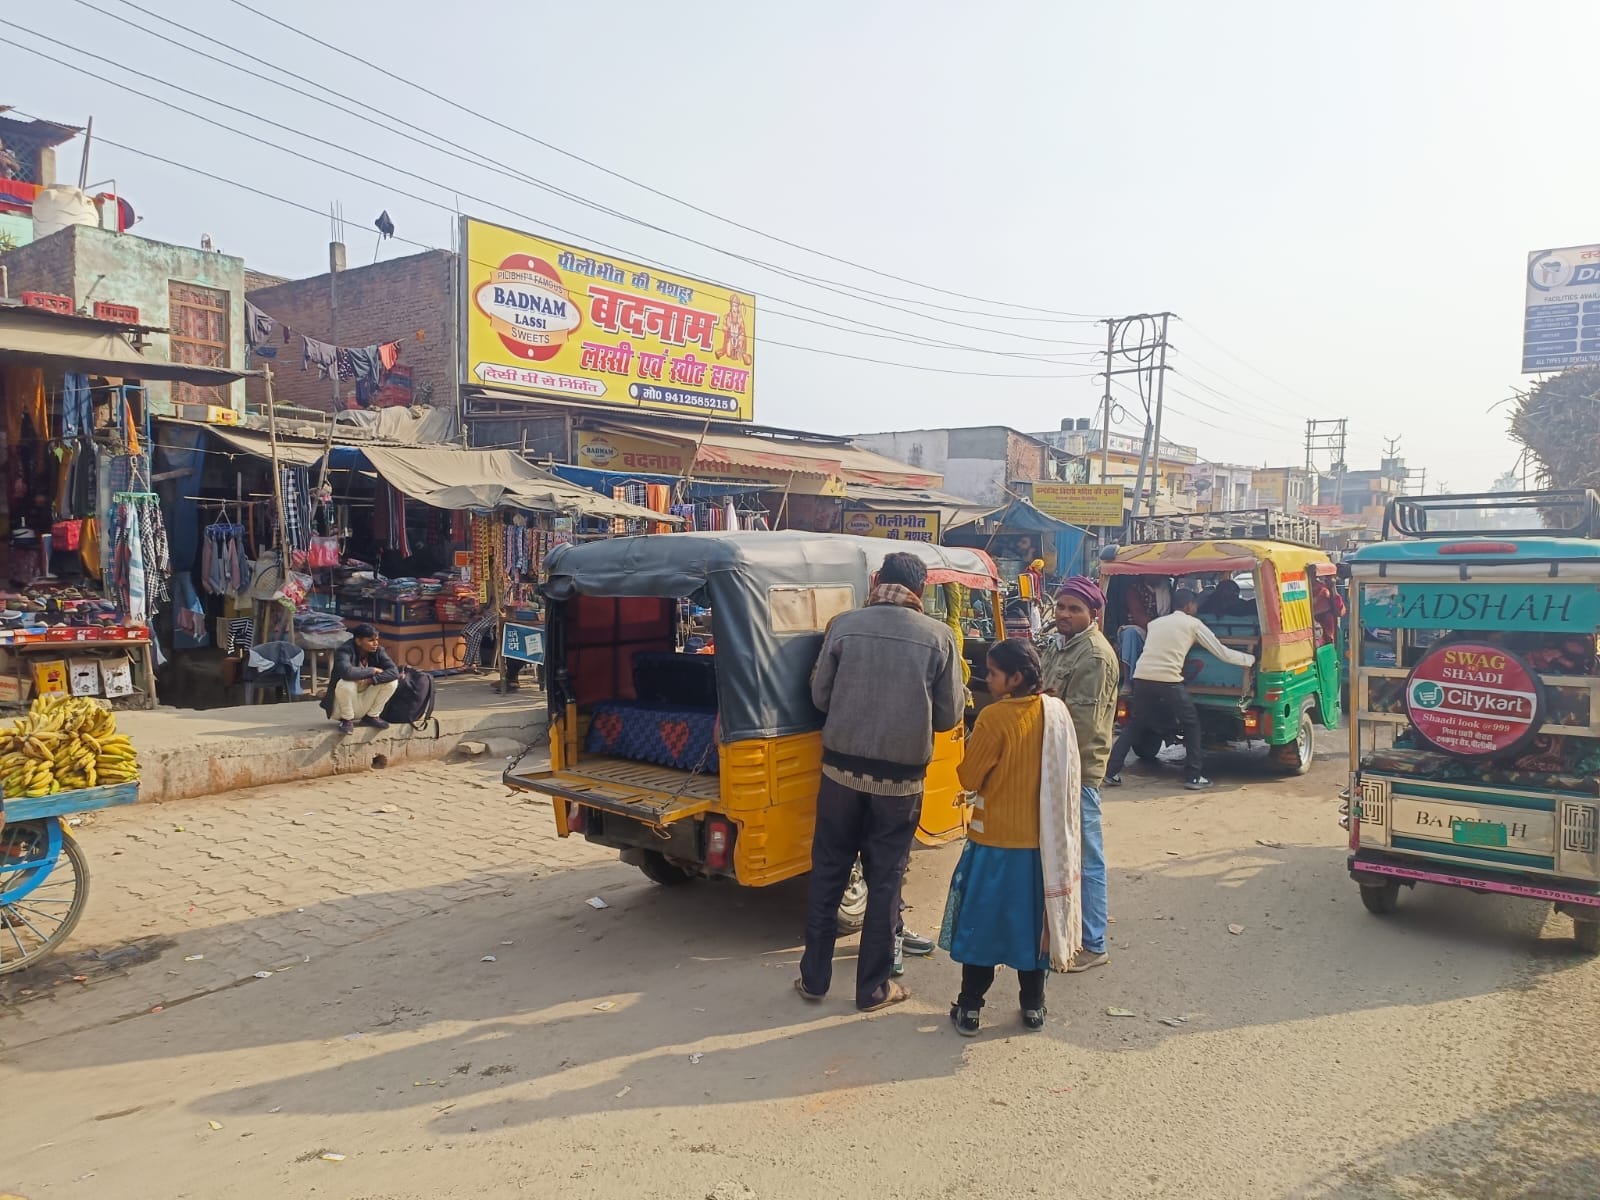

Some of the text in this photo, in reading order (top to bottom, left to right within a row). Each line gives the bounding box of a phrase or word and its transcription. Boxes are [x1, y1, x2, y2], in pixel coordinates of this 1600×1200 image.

[558, 252, 625, 284] पीलीभीत
[631, 272, 650, 291] की
[494, 286, 567, 318] BADNAM
[515, 314, 546, 329] LASSI
[588, 285, 719, 351] बदनाम
[511, 327, 550, 344] SWEETS
[580, 341, 749, 392] लस्सी एवं स्वीट हाउस
[486, 367, 517, 381] देसी
[542, 376, 555, 387] से
[559, 377, 598, 393] निर्मित
[623, 452, 682, 470] बदनाम
[875, 514, 926, 528] पीलीभीत
[887, 529, 899, 540] की
[1444, 650, 1506, 670] SWAG
[1442, 667, 1504, 684] SHAADI
[1447, 689, 1523, 712] Citykart
[1423, 713, 1456, 724] Shaadi
[1458, 717, 1480, 729] look
[1492, 724, 1511, 732] 999
[1416, 811, 1528, 838] BADH
